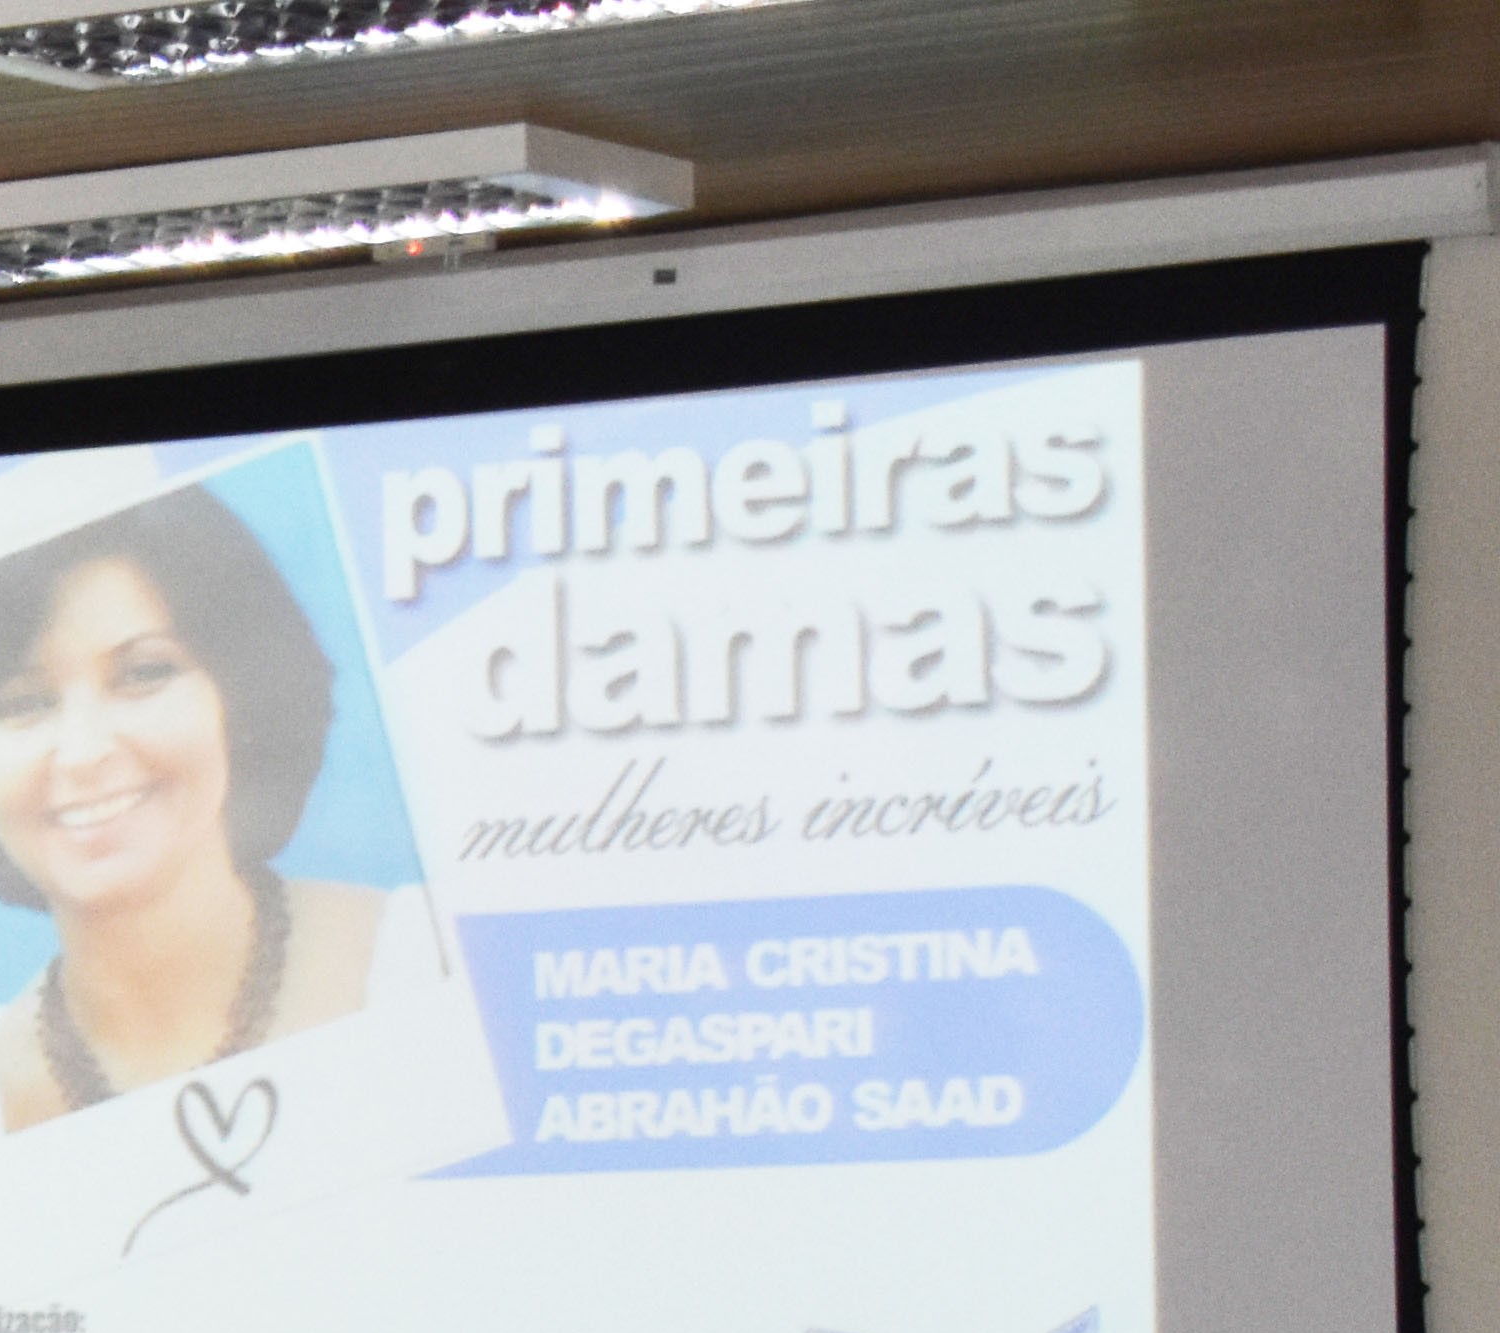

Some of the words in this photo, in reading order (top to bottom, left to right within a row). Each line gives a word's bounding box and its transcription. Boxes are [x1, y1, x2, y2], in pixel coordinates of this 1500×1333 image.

[381, 399, 1113, 604] primeiras
[463, 564, 1114, 744] damas
[459, 755, 781, 861] mulheres
[801, 757, 1118, 843] incríveis
[534, 944, 728, 999] MARIA
[745, 927, 1039, 991] CRISTINA
[535, 1007, 873, 1070] DEGASPARI
[535, 1072, 833, 1143] ABRAHÃO
[851, 1075, 1025, 1131] SAAD
